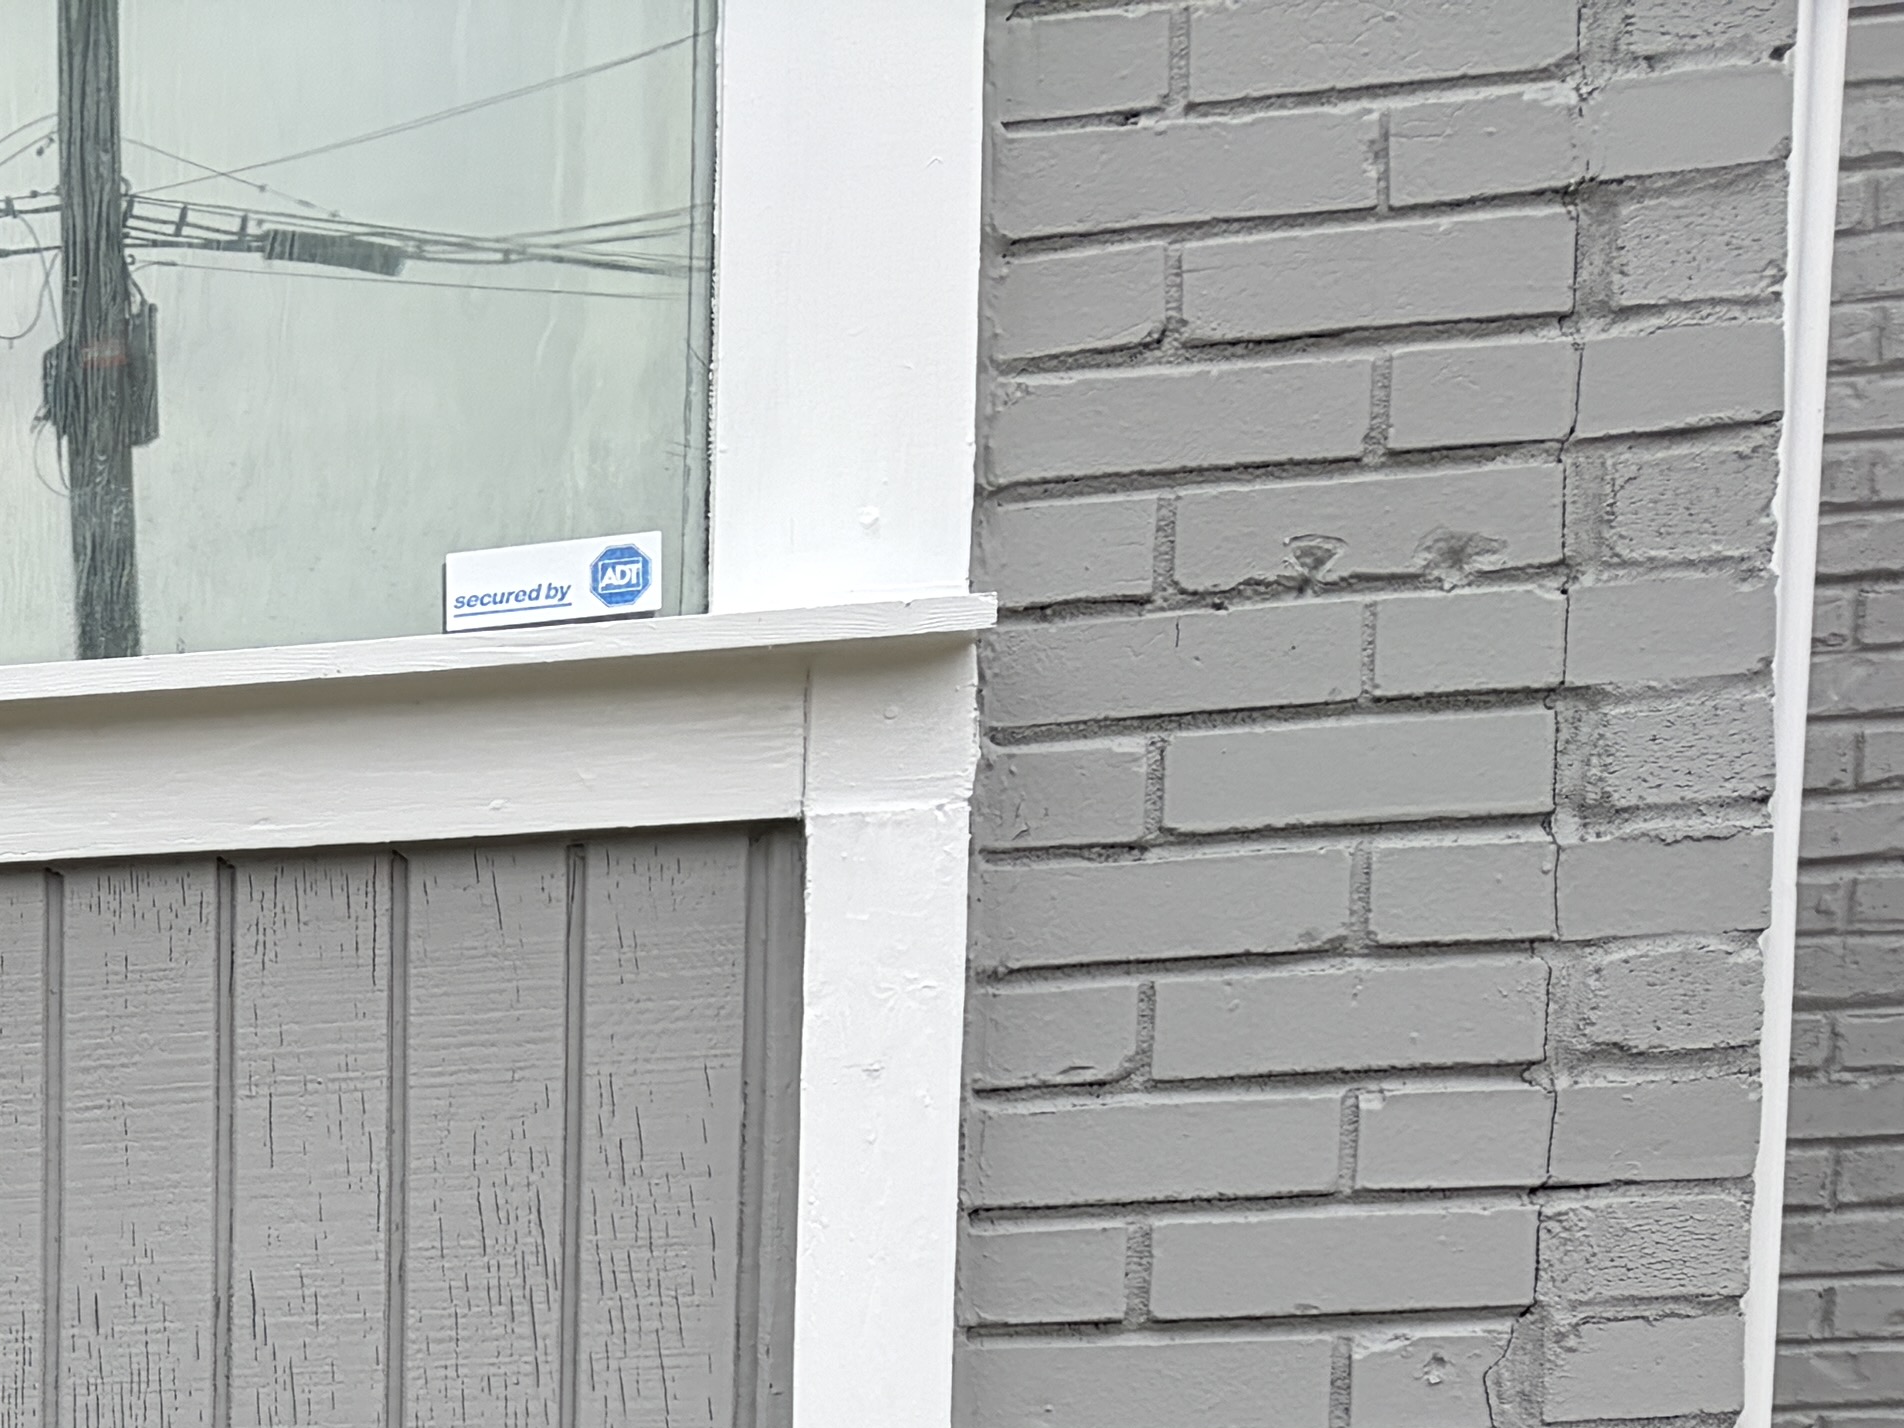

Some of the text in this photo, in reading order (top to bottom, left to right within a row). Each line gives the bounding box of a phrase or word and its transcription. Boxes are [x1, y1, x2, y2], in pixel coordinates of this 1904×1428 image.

[600, 563, 641, 587] ADT
[453, 581, 573, 610] secured by
